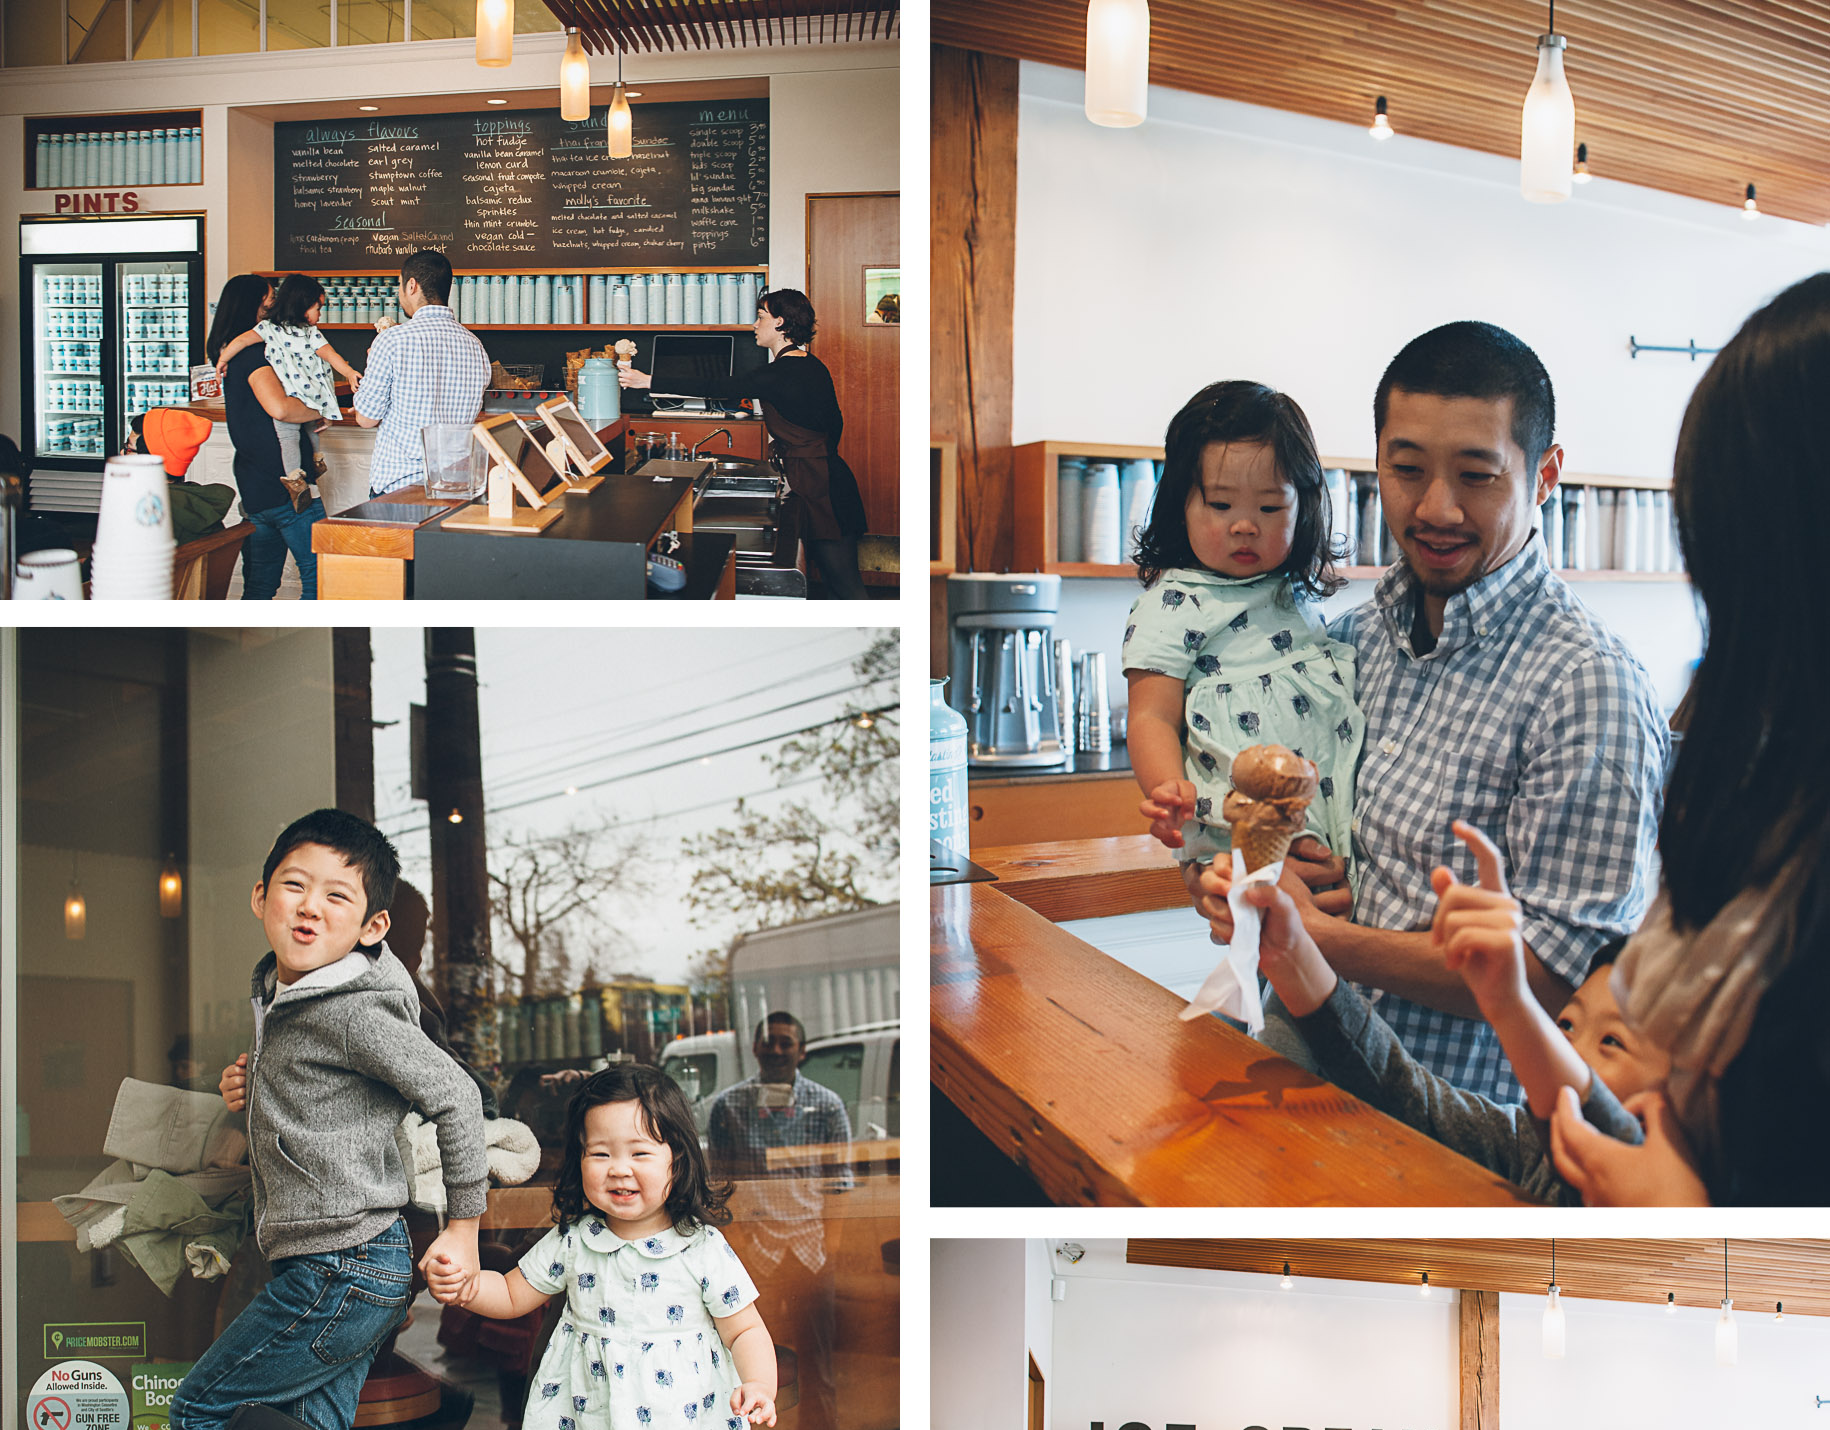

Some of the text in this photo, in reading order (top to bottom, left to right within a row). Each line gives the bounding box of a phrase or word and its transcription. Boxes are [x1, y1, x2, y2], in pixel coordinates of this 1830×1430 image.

[699, 110, 748, 121] menu
[474, 117, 531, 138] toppings
[306, 122, 419, 146] always flavors
[689, 128, 743, 140] single scoop
[368, 142, 439, 153] salted caramel
[476, 136, 528, 150] hot fudge
[560, 138, 581, 147] thai
[690, 139, 744, 149] double scoop
[292, 147, 343, 156] vanilla bean
[464, 151, 491, 159] vanilla
[515, 148, 544, 156] caramel
[714, 152, 737, 160] scoop
[368, 156, 413, 169] earl grey
[476, 159, 528, 169] lemon curd
[552, 155, 568, 163] thai
[570, 154, 585, 162] tea
[712, 162, 734, 171] scoop
[369, 169, 443, 182] stumptown coffee
[463, 173, 493, 182] seasonal
[517, 172, 546, 183] compote
[551, 169, 590, 177] macaroon
[704, 172, 736, 180] sundae
[292, 174, 338, 185] strawberry
[370, 185, 394, 195] maple
[484, 183, 515, 196] cajeta
[553, 181, 587, 192] whipped
[691, 184, 735, 194] big sundae
[294, 186, 362, 199] balsamic strawberry
[55, 192, 139, 213] PINTS
[294, 199, 353, 211] honey lavender
[371, 196, 421, 206] scout mint
[466, 195, 532, 205] balsamic redux
[565, 194, 647, 208] molly's favorite
[477, 208, 517, 220] sprinkles
[692, 206, 735, 214] milkshake
[552, 213, 574, 221] melted
[611, 212, 623, 220] and
[627, 212, 648, 220] salted
[691, 217, 717, 226] waffle
[464, 219, 539, 228] thin mint crumble
[475, 232, 503, 244] vegan
[691, 230, 729, 240] toppings
[366, 244, 392, 255] rhubarb
[395, 244, 417, 255] vanilla
[467, 243, 510, 252] chocolate
[592, 240, 619, 250] whipped
[693, 241, 716, 254] pints
[200, 381, 218, 394] Hot
[930, 779, 953, 805] ed
[930, 803, 968, 830] sting
[66, 1336, 139, 1347] PRICEMOBSTER.COM
[52, 1370, 102, 1382] No Guns
[46, 1381, 108, 1391] Allowed Inside.
[132, 1375, 184, 1390] Chino
[146, 1391, 174, 1406] Boo
[76, 1413, 120, 1423] GUN FREE
